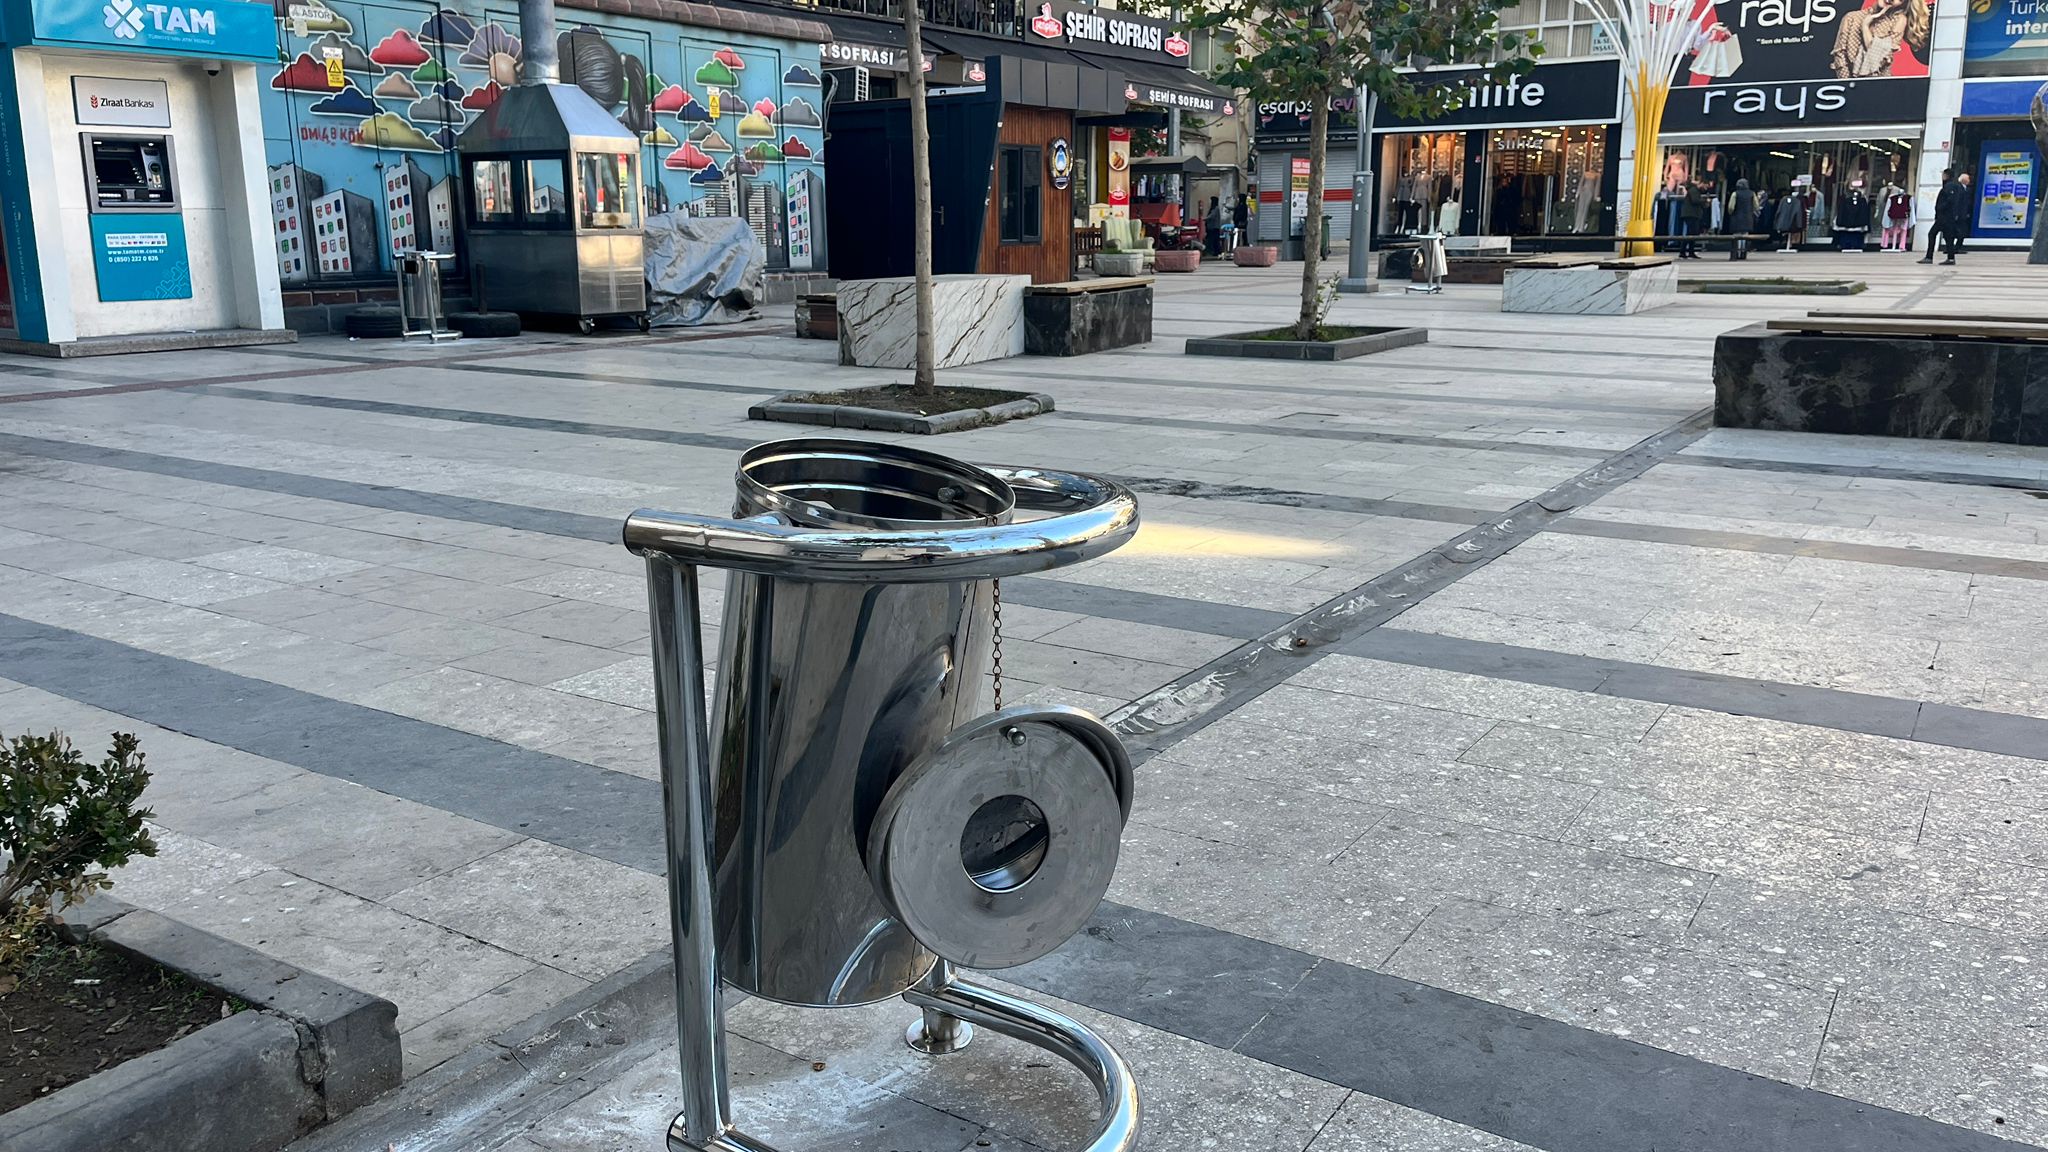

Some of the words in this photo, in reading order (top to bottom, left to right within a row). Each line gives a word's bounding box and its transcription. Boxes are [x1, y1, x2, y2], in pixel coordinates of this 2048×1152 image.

[302, 9, 330, 20] ASTOR
[1739, 0, 1836, 34] rays
[2009, 0, 2048, 15] Turk
[146, 4, 216, 36] TAM
[1066, 9, 1106, 44] ŞEHİR
[1109, 19, 1162, 51] SOFRASI
[831, 44, 894, 66] SOFRASI
[100, 97, 124, 108] Ziraat
[124, 98, 154, 109] Bankası
[1149, 89, 1177, 104] ŞEHİR
[1177, 94, 1214, 110] SOFRASI
[1703, 84, 1846, 119] rays
